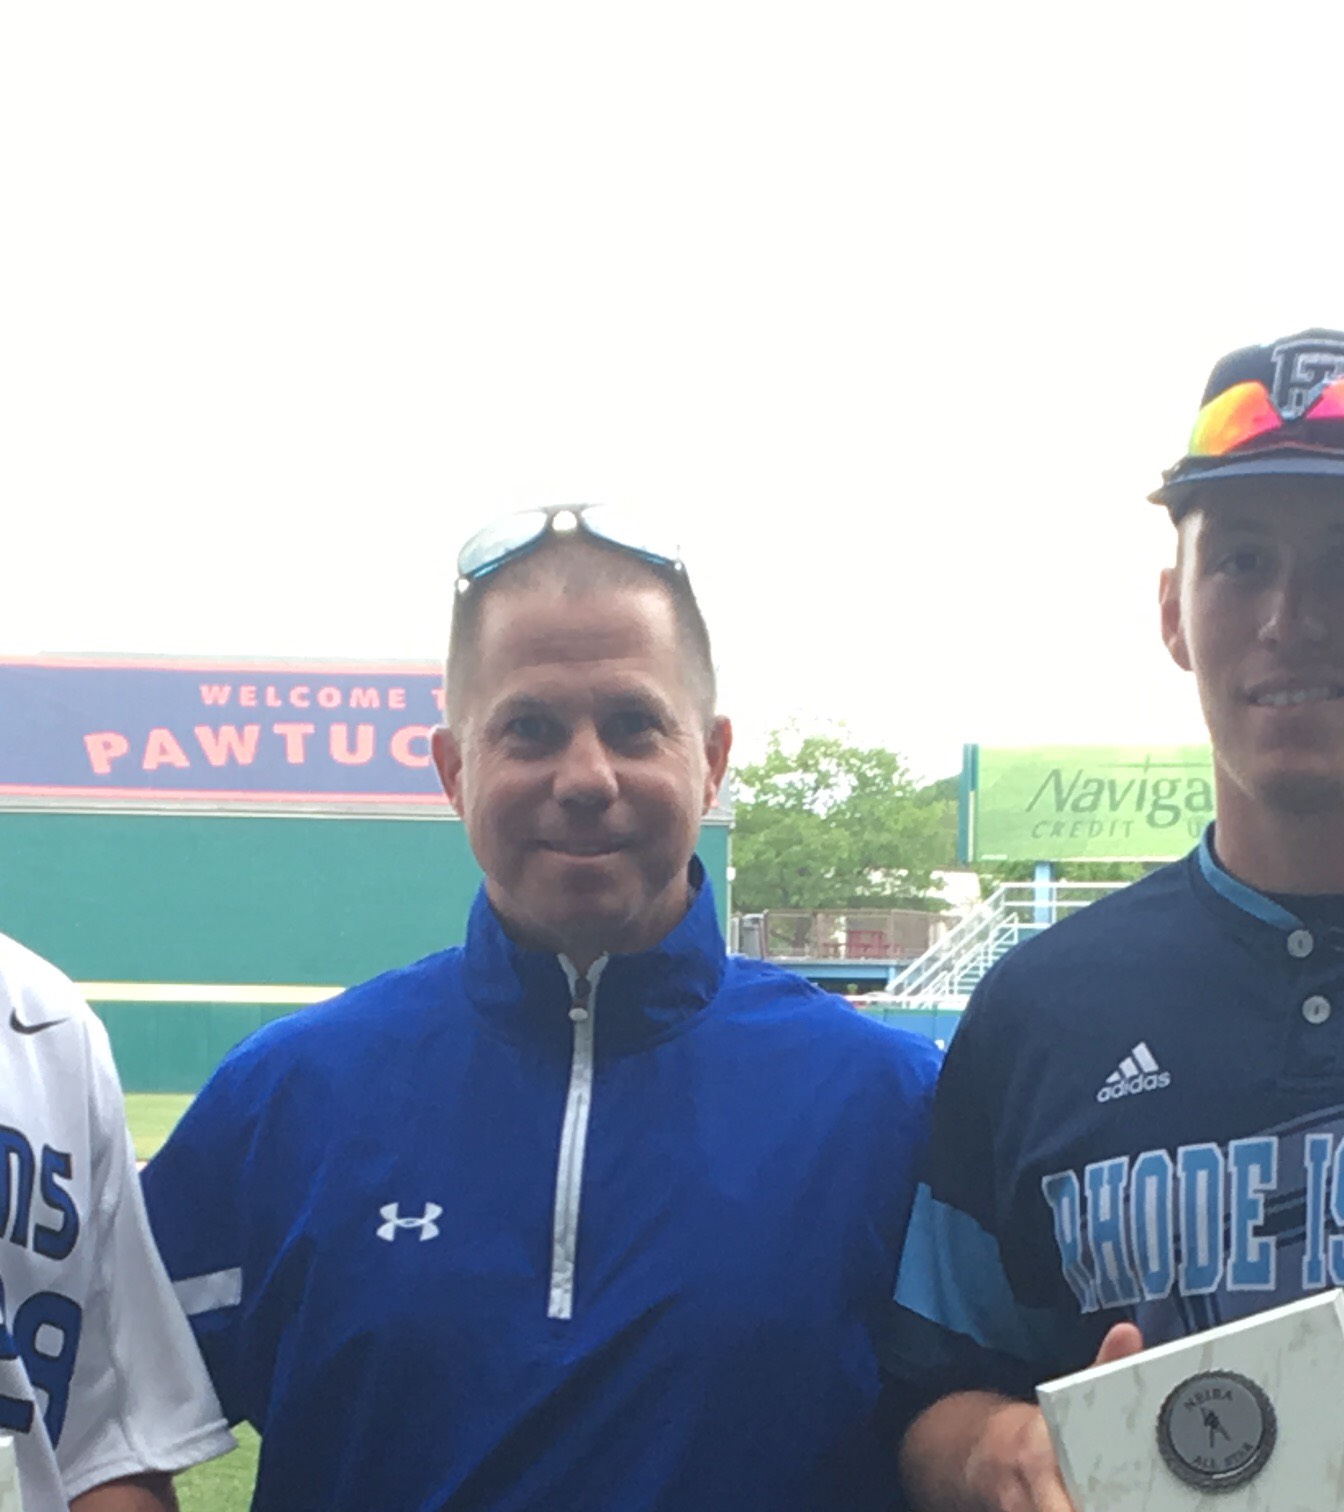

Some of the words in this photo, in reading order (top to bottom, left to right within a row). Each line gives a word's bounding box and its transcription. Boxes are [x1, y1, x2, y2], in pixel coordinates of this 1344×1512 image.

[199, 684, 407, 709] WELCOME
[83, 723, 432, 776] PAWTUC
[1025, 768, 1214, 829] Naviga
[1031, 819, 1135, 840] CREDIT
[1096, 1070, 1171, 1103] adidas
[1041, 1134, 1280, 1314] RHODE
